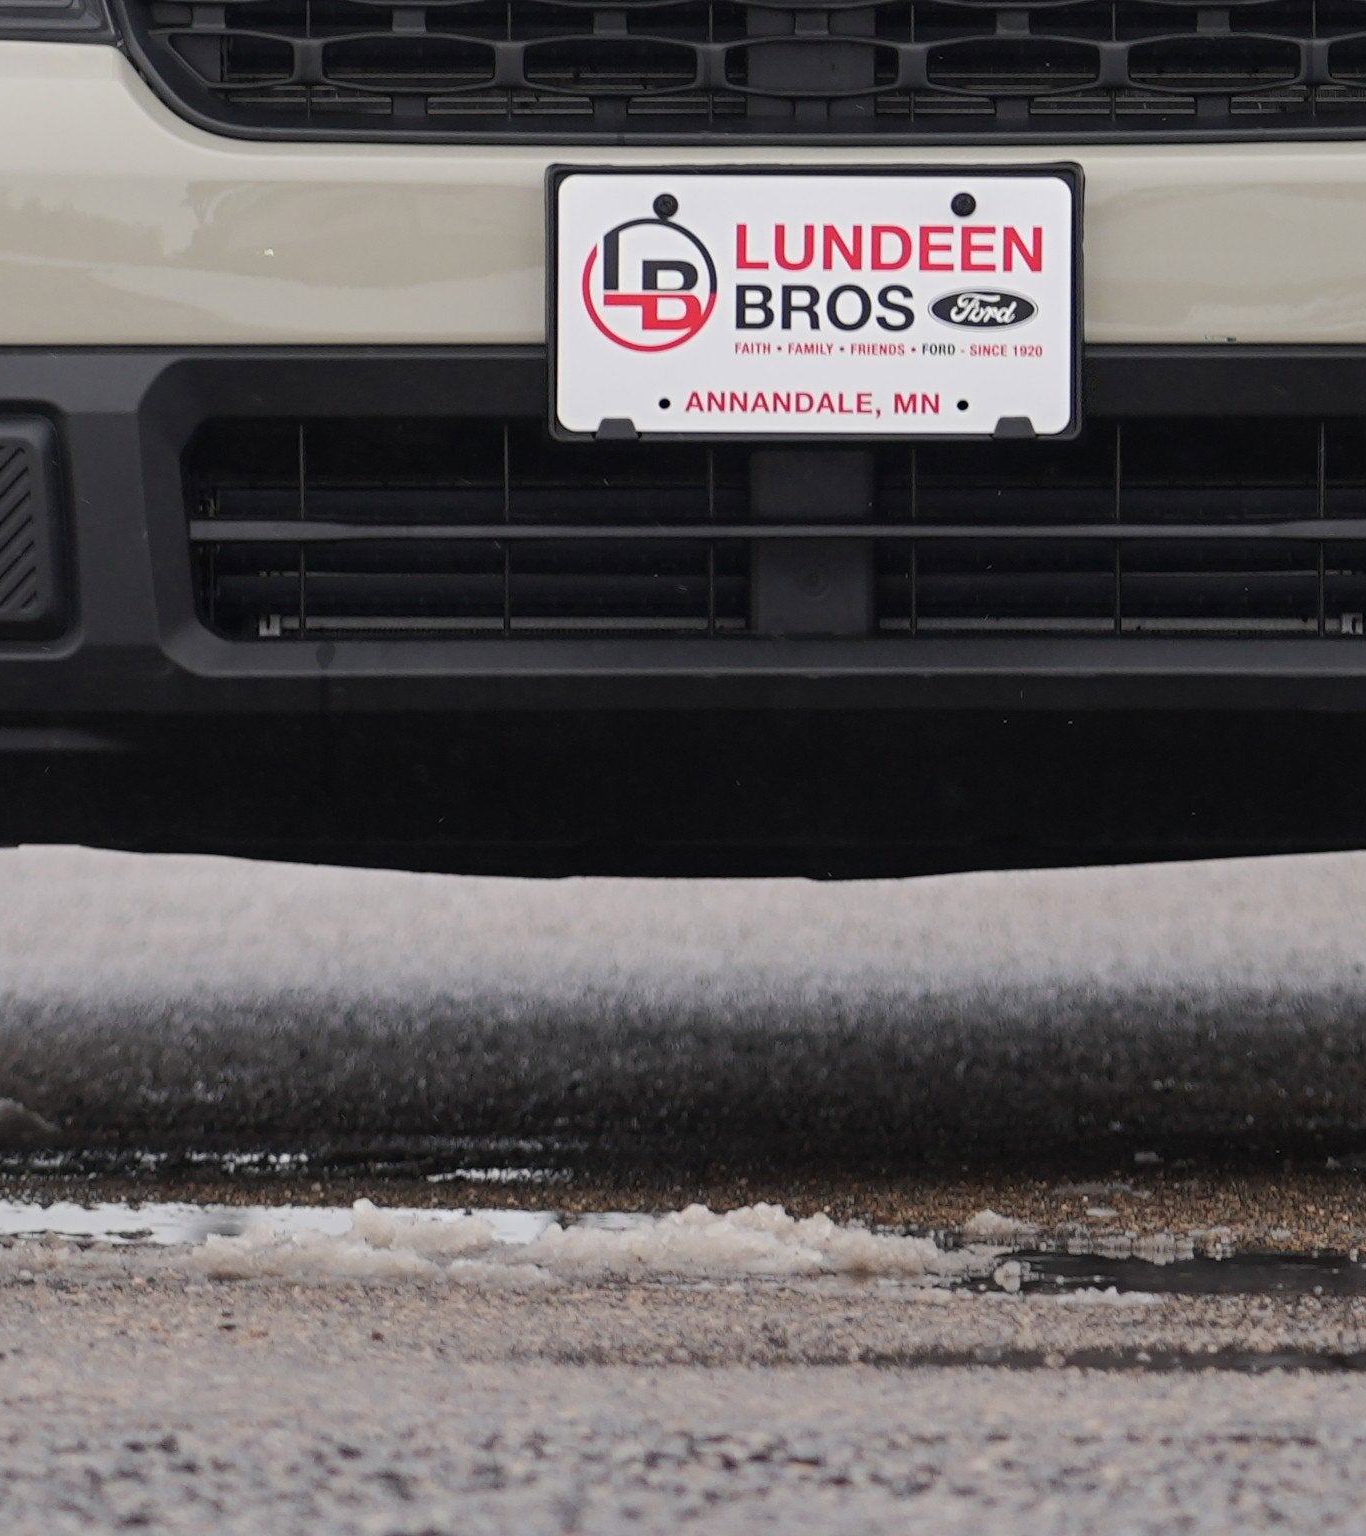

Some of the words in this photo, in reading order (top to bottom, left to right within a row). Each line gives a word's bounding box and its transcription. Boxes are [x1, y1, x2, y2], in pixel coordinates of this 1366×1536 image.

[736, 224, 1043, 272] LUNDEEN
[735, 284, 915, 331] BROS
[950, 293, 1017, 324] Ford
[734, 342, 771, 355] FAITH
[787, 342, 834, 356] FAMILY
[850, 343, 905, 356] FRIENDS
[921, 343, 956, 356] FORD
[969, 344, 1008, 357] SINCE
[1013, 345, 1043, 357] 1920
[685, 391, 881, 418] ANNANDALE,
[893, 393, 940, 414] MN
